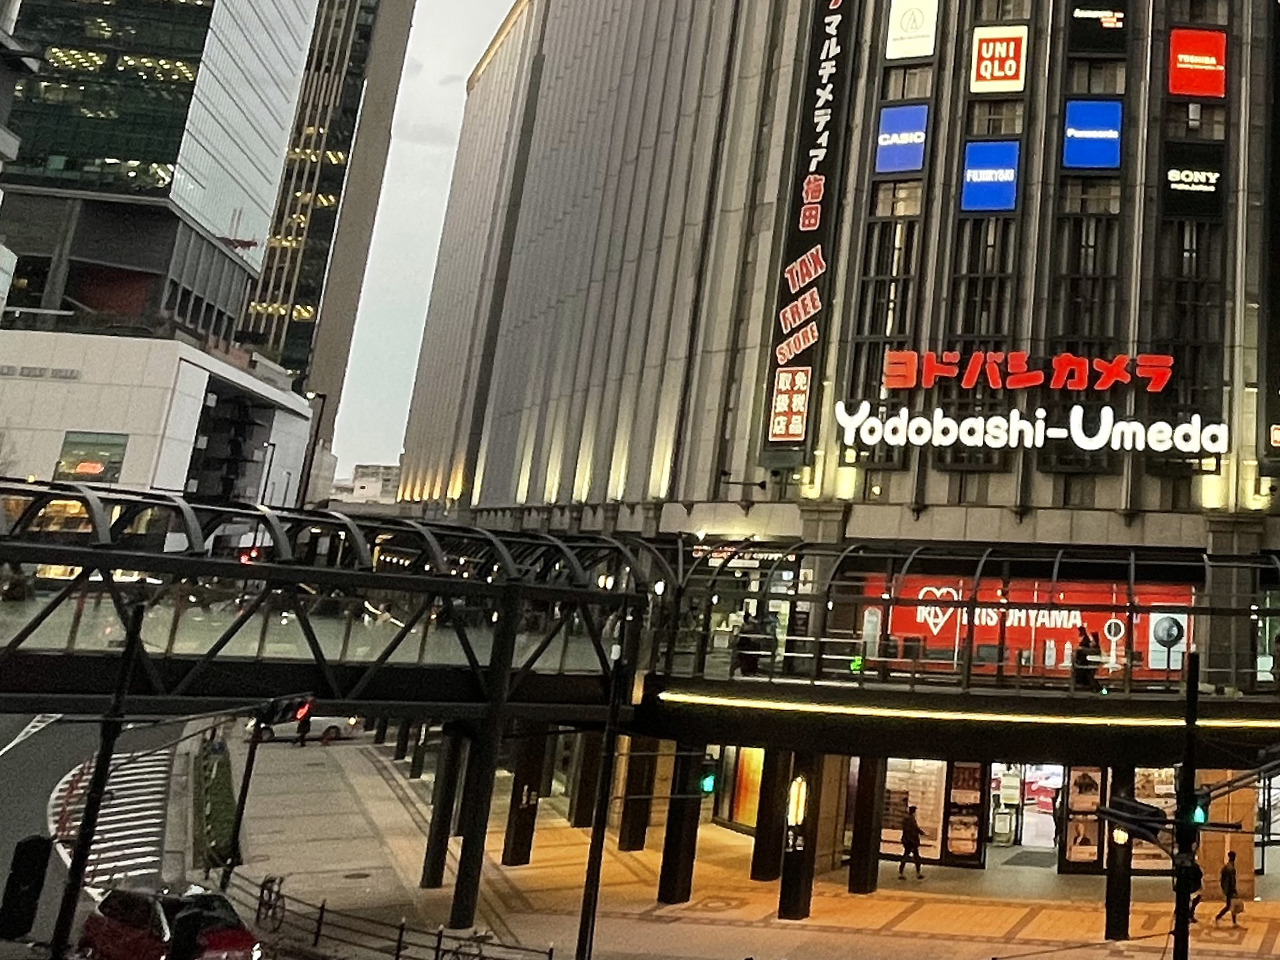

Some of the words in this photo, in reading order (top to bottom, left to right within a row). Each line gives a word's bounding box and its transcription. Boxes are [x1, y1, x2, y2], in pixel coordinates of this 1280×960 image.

[980, 59, 1017, 79] QLO
[981, 41, 1015, 58] UNI
[878, 131, 926, 146] CASIO
[1167, 169, 1220, 184] SONY
[784, 244, 826, 294] TAX
[779, 286, 822, 335] FREE
[776, 321, 819, 365] STORE
[882, 350, 1174, 392] ヨドバシカメラ
[835, 399, 1229, 454] Yodobashi-Umeda
